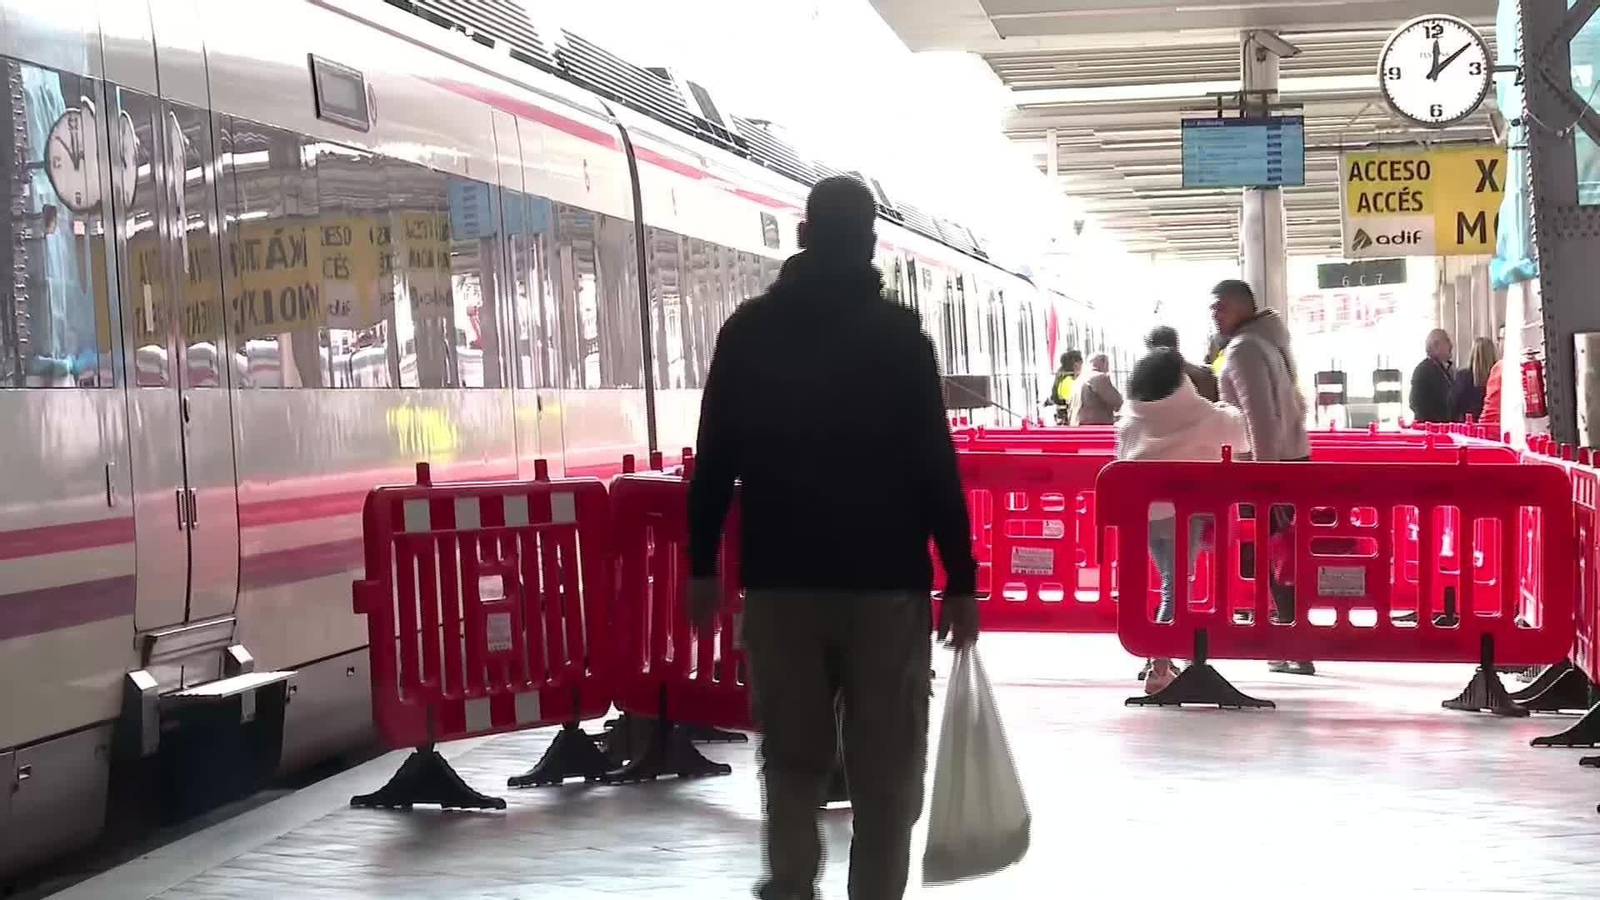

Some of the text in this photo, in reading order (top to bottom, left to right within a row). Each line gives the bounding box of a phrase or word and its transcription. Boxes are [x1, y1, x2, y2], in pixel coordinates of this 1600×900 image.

[1424, 24, 1444, 39] 12
[1388, 67, 1401, 80] 9
[1469, 62, 1481, 75] 3
[1430, 104, 1443, 117] 6
[1348, 160, 1431, 182] ACCESO
[1475, 159, 1505, 193] X
[1357, 187, 1424, 213] ACCÉS
[1456, 211, 1499, 245] M
[1376, 230, 1423, 245] adif
[1342, 275, 1350, 287] 6
